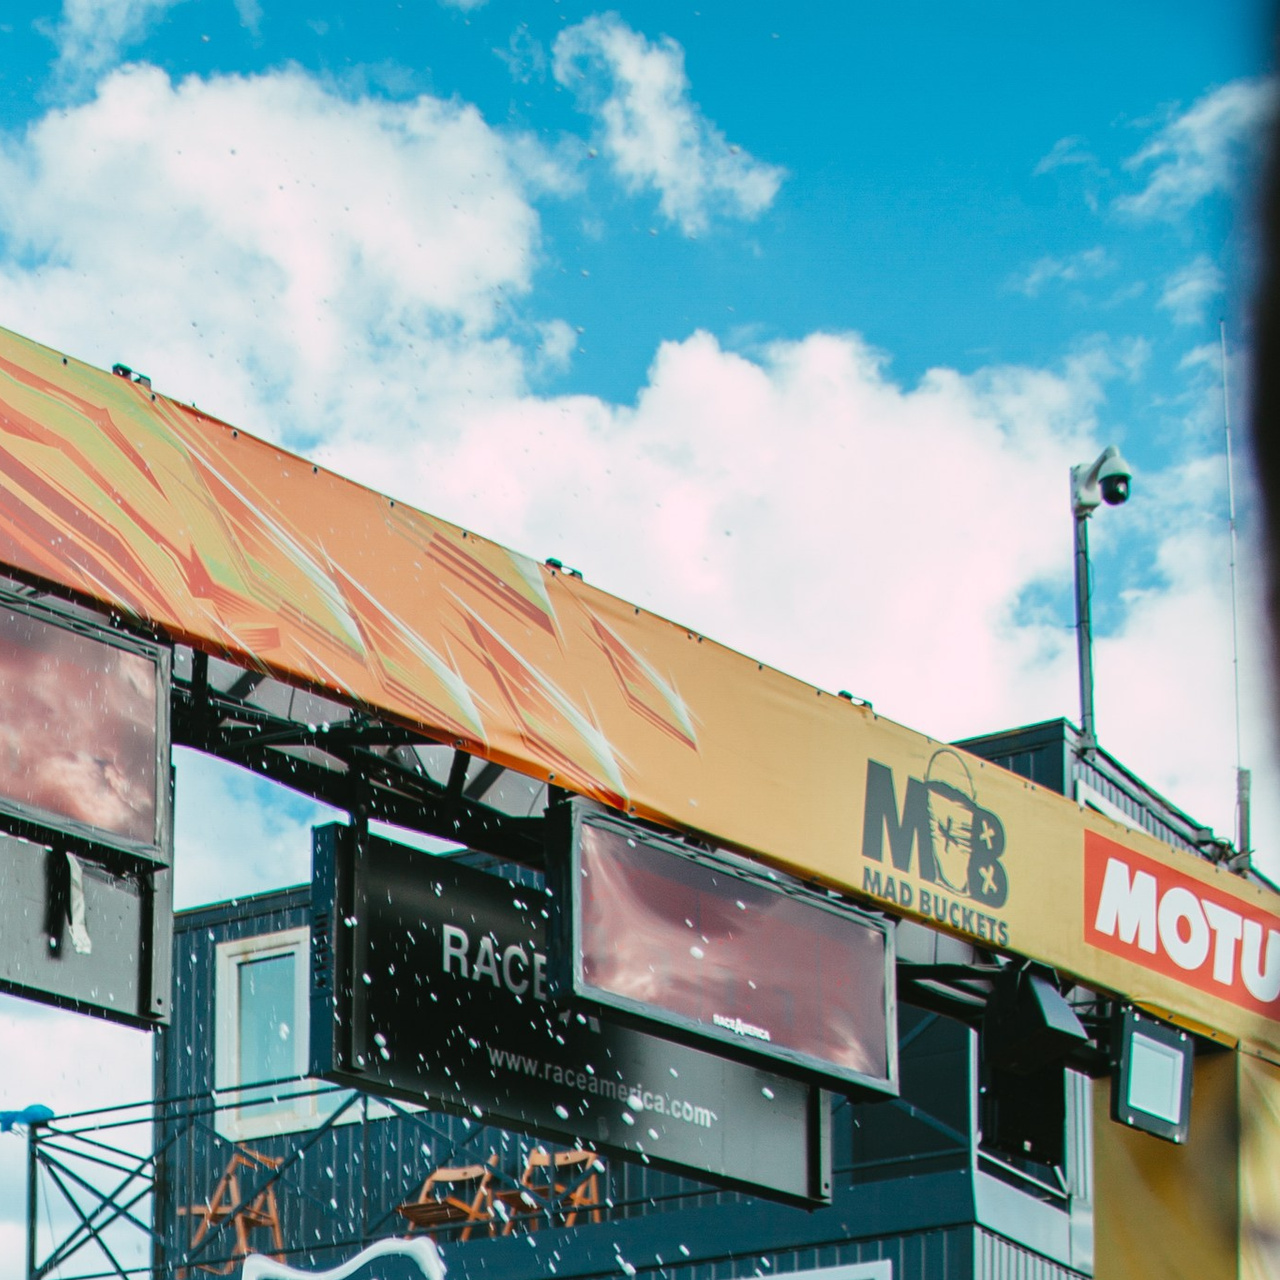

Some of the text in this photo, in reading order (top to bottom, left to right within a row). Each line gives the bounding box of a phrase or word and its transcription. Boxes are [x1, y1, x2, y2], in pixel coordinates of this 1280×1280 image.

[862, 865, 1010, 947] MAD BUCKETS
[1094, 857, 1280, 1003] MOTU
[487, 1046, 712, 1129] www.raceamerica.com
